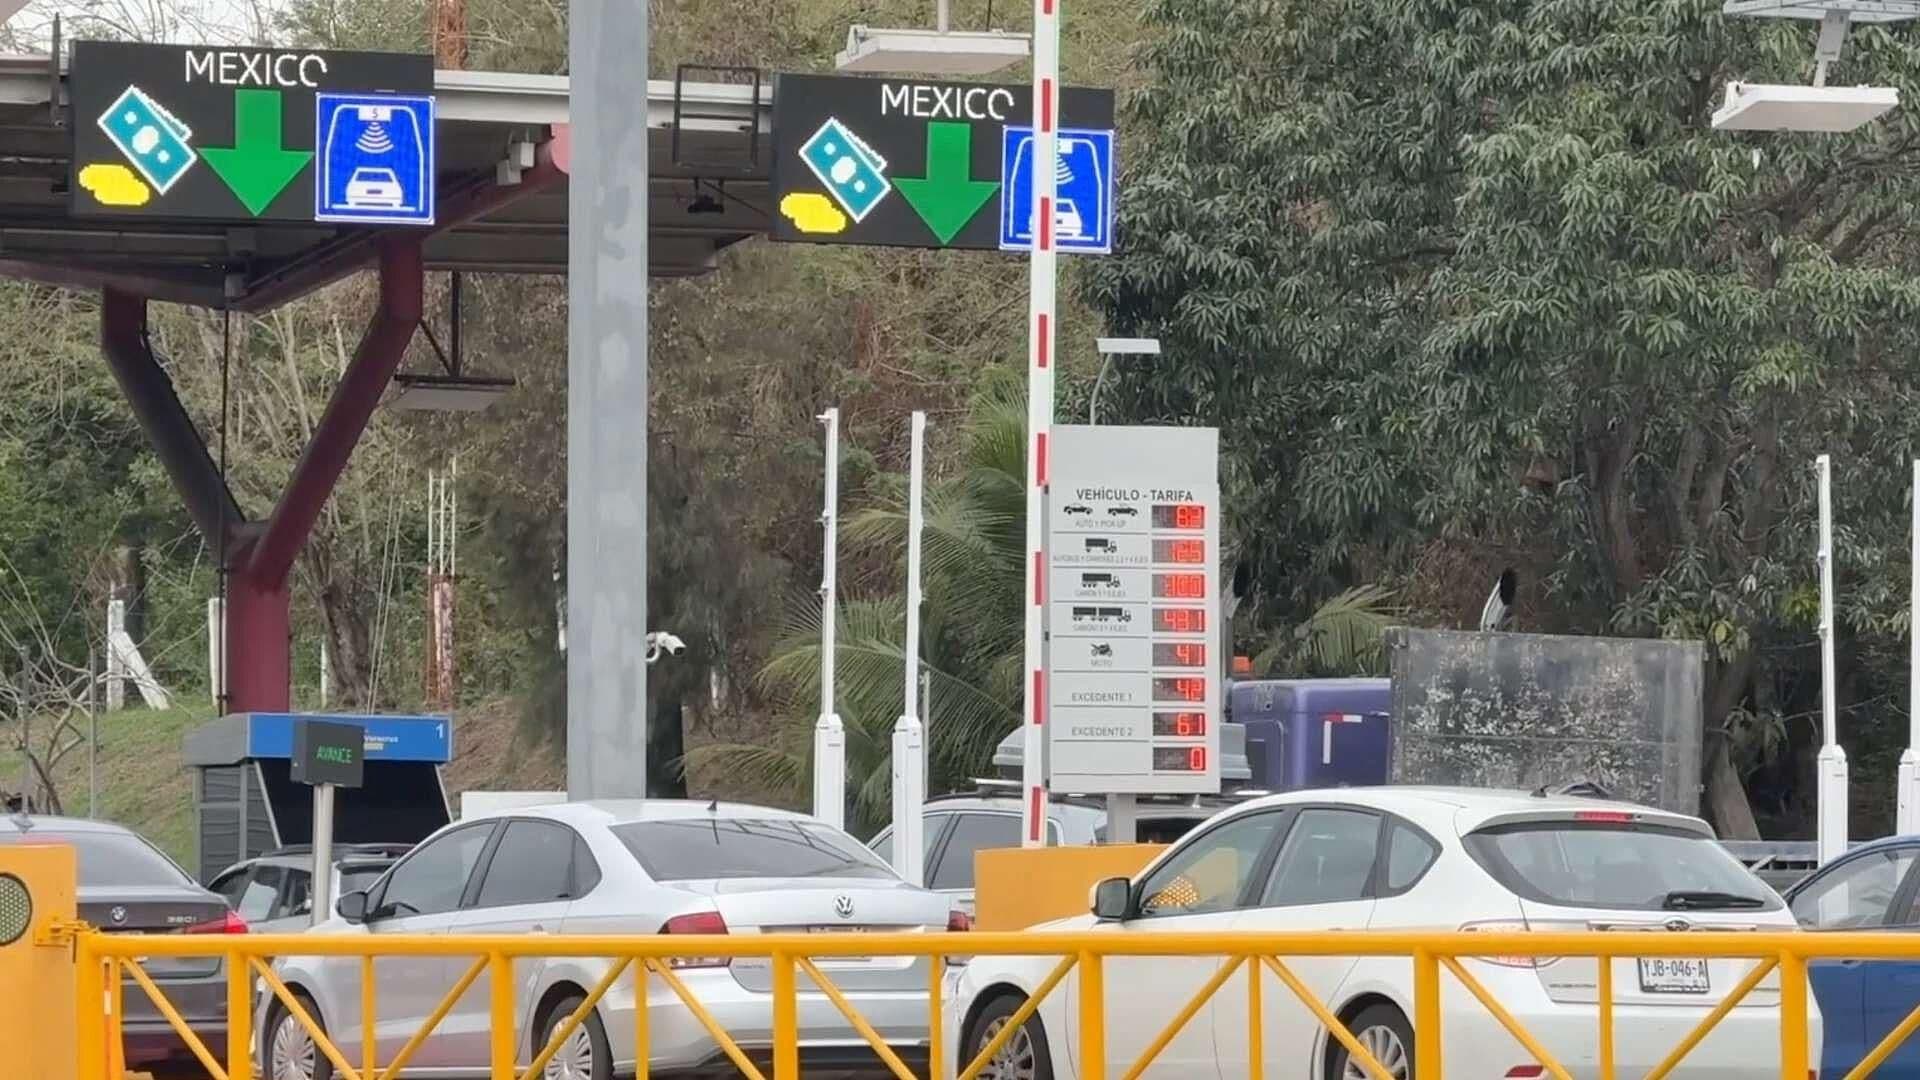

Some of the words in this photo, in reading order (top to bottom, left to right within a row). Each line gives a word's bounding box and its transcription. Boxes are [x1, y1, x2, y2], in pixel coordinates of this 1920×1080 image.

[185, 50, 328, 88] MEXICO
[881, 83, 1015, 121] MEXICO
[1076, 486, 1140, 501] VEHÍCULO
[1150, 488, 1194, 502] TARIFA
[1176, 645, 1203, 665] 41
[1071, 693, 1125, 702] EXCEDENTE
[1128, 693, 1132, 702] 1
[1176, 680, 1203, 701] 42
[435, 723, 444, 739] 1
[1071, 726, 1125, 737] EXCEDENTE
[1127, 726, 1133, 737] 2
[1176, 713, 1203, 736] 61
[316, 746, 353, 764] AVANCE
[1191, 748, 1203, 770] 0
[1643, 959, 1705, 977] YJB-046-A
